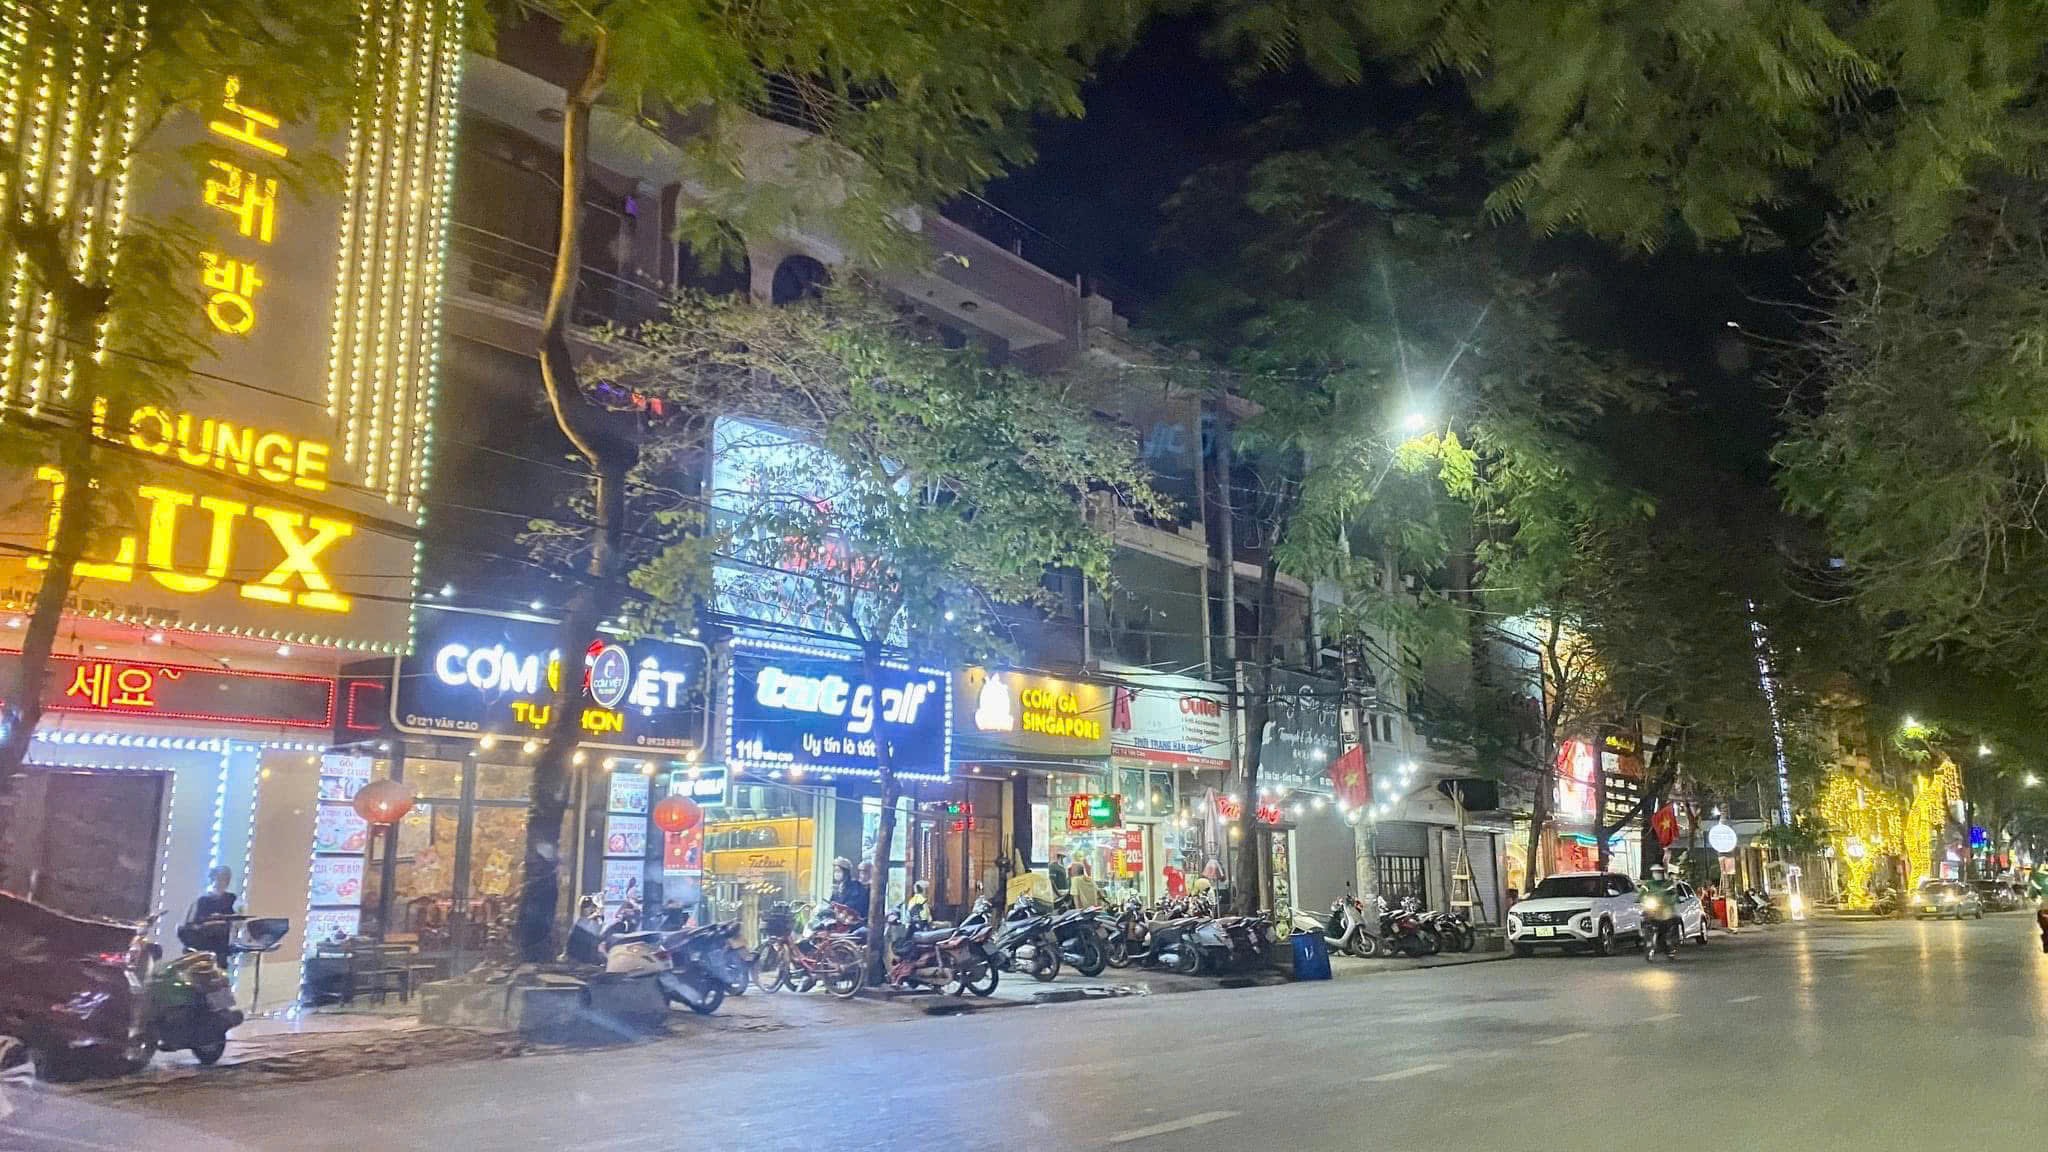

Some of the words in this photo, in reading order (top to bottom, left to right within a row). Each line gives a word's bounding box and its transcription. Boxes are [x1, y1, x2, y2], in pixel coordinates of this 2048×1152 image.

[201, 76, 288, 336] 노래방
[92, 396, 330, 490] LOUNGE
[27, 467, 353, 613] LUX
[436, 643, 539, 694] CƠM
[1058, 692, 1077, 713] GÀ
[456, 720, 479, 730] CAO
[581, 709, 624, 735] HỌN
[1022, 711, 1100, 739] SINGAPORE
[803, 733, 821, 757] Uy
[823, 735, 840, 753] tín
[843, 736, 857, 755] là
[858, 738, 876, 758] tất
[1151, 739, 1171, 751] TRANG
